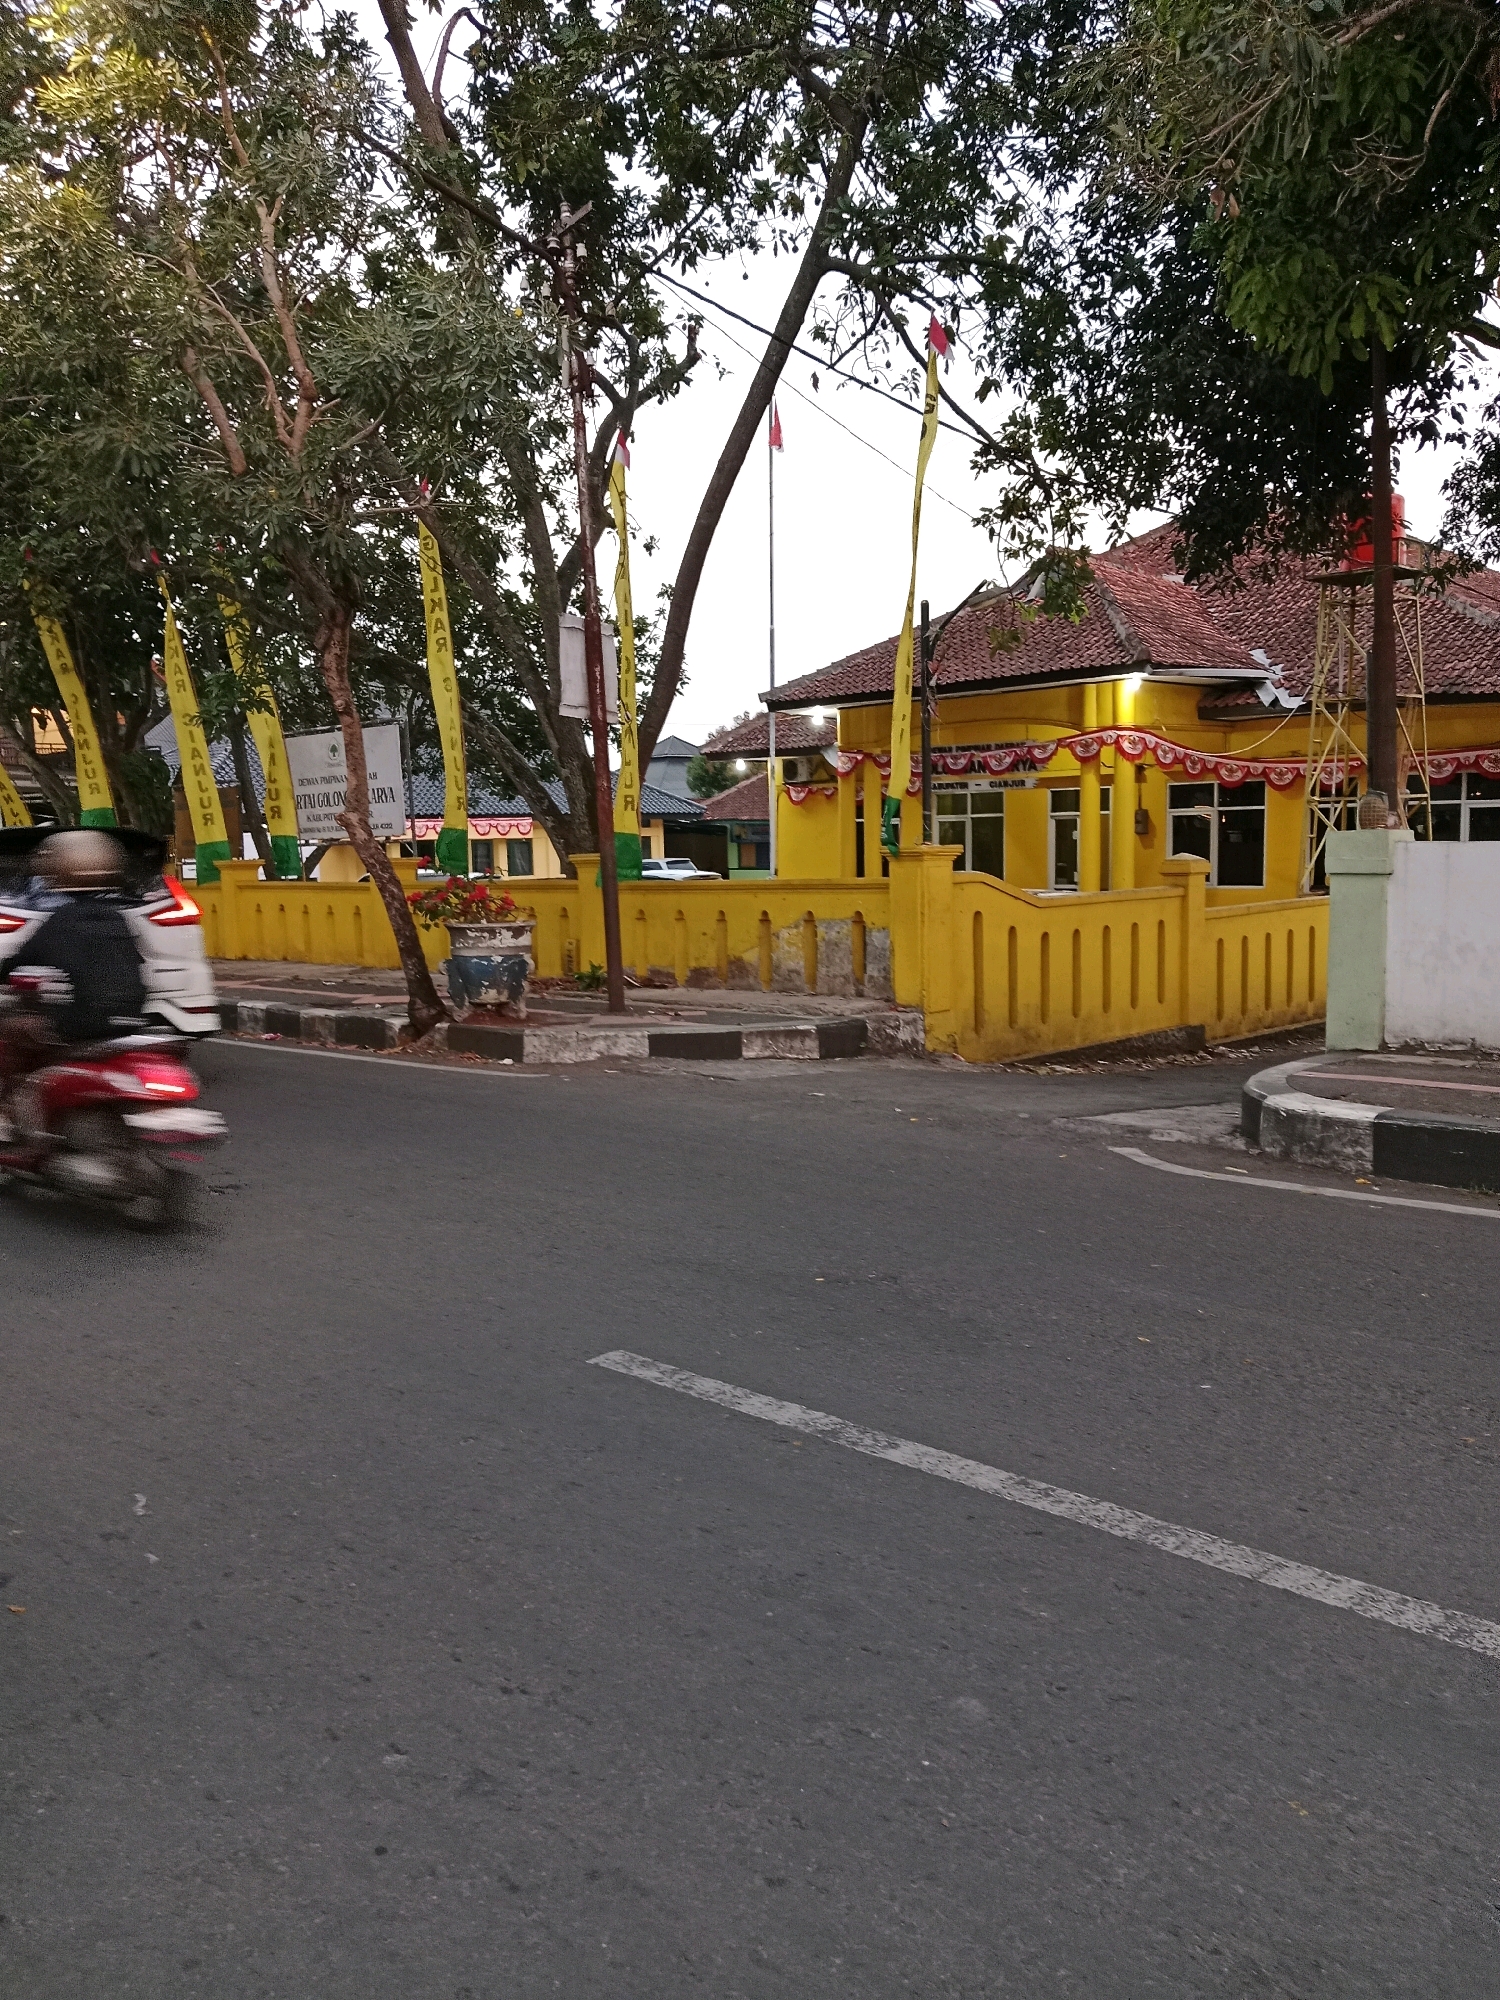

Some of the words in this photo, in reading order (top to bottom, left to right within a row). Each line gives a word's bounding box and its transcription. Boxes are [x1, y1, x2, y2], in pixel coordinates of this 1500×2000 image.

[931, 782, 969, 790] ABUPATEN
[990, 780, 1026, 789] CIANJUR
[318, 791, 348, 808] GOLON
